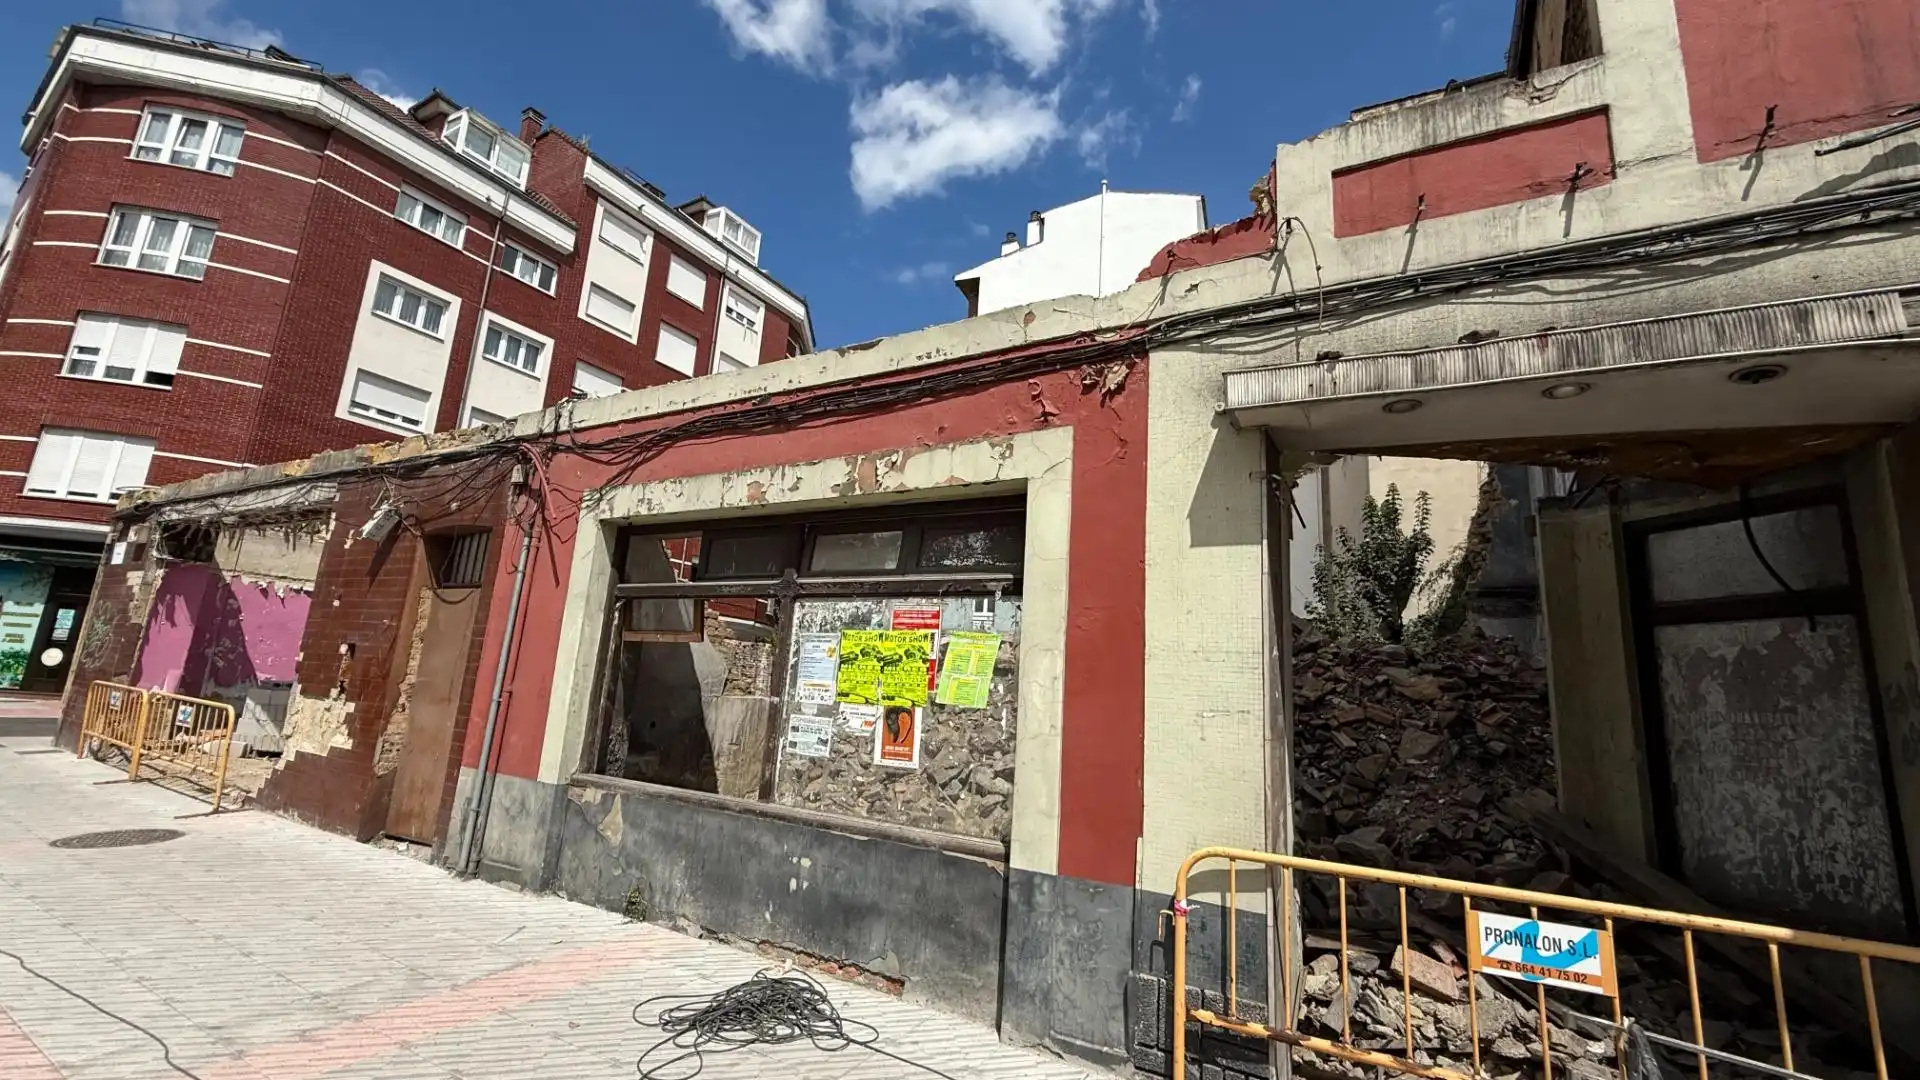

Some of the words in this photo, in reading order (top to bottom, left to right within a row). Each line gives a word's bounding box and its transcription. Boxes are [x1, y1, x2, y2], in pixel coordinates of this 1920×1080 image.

[864, 632, 884, 642] SHOW
[884, 632, 907, 643] MOTOR
[908, 632, 929, 643] SHOW
[1484, 926, 1562, 953] PRONALON
[1515, 962, 1535, 975] 664
[1539, 967, 1551, 977] 41
[1558, 969, 1570, 981] 75
[1573, 972, 1587, 983] 02
